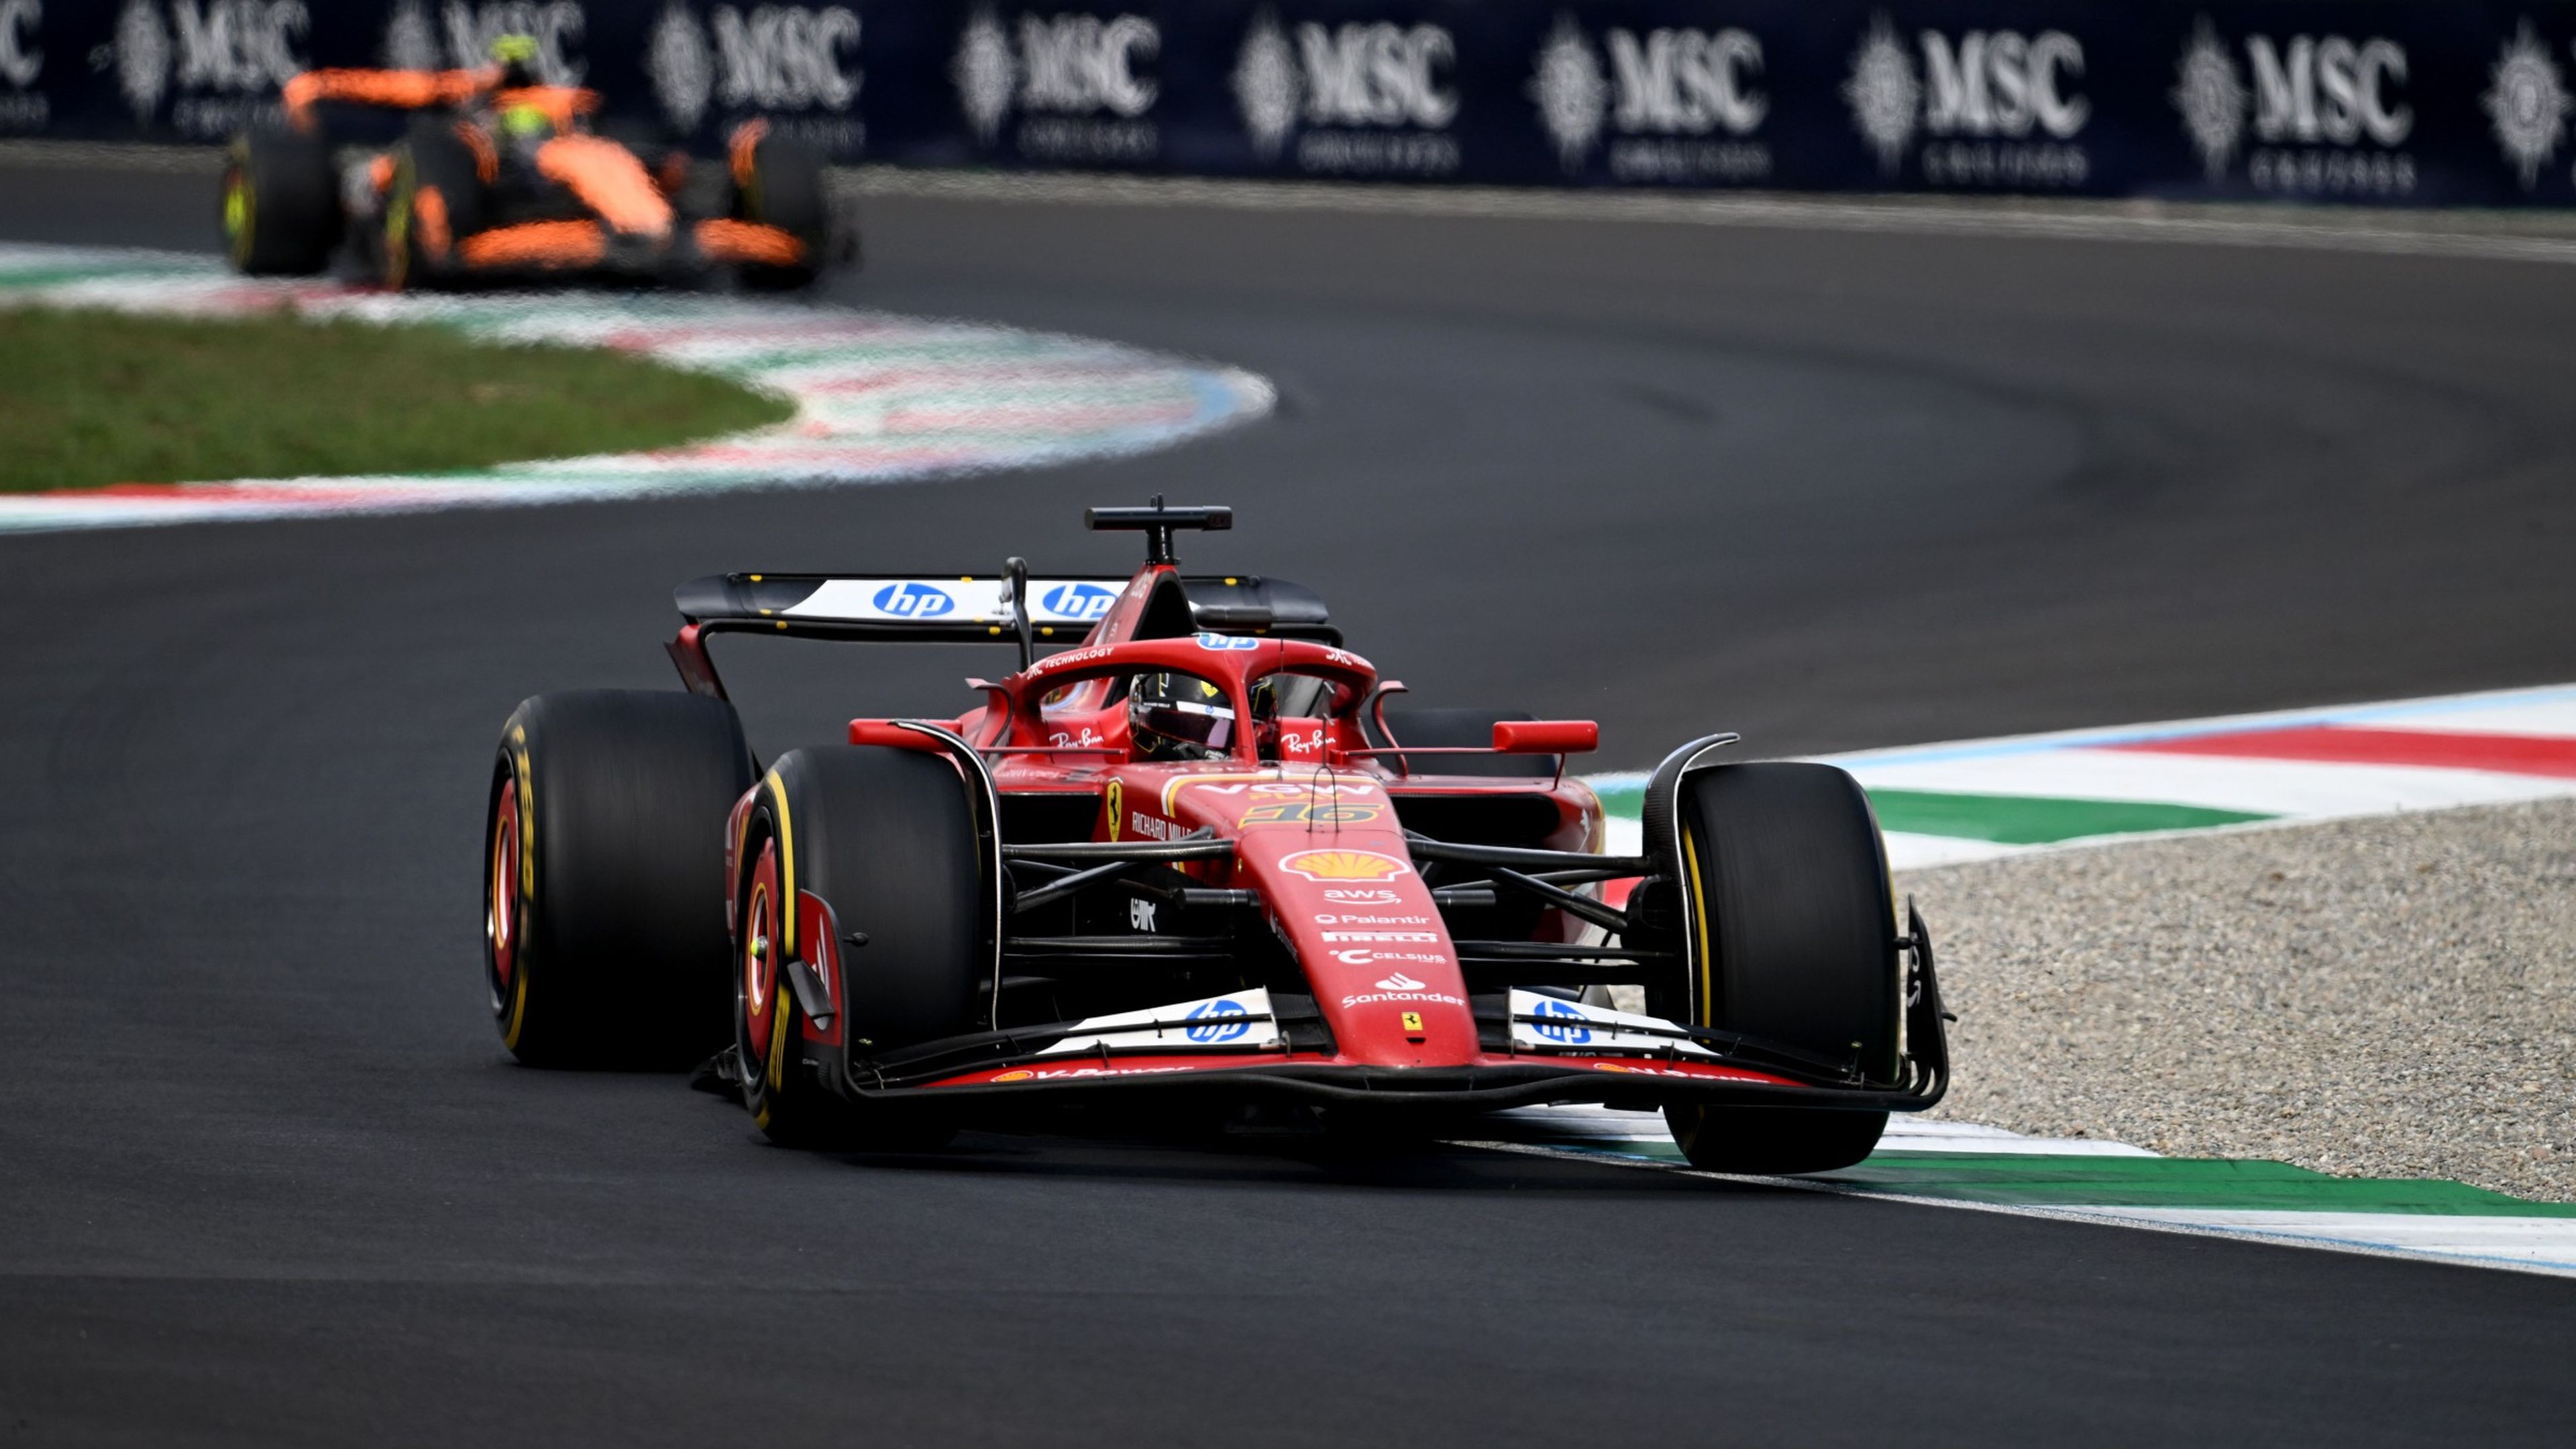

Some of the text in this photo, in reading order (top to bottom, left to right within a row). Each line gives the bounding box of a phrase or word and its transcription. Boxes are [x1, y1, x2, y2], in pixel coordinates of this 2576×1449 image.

[712, 4, 864, 109] MSC
[1298, 21, 1459, 127] MSC
[1607, 27, 1769, 133] MSC
[1920, 31, 2091, 138] MSC
[2244, 34, 2414, 146] MSC
[884, 582, 947, 619] hp
[1053, 584, 1117, 619] hp
[1045, 647, 1114, 669] TECHNOLOGY
[1194, 783, 1375, 796] VGW
[1132, 811, 1166, 841] RICHARD
[1237, 803, 1385, 830] 16
[1324, 890, 1397, 900] aws
[1341, 914, 1431, 924] Palantir
[1321, 931, 1438, 943] PIRELLI
[1373, 952, 1446, 961] CELSIUS
[1342, 991, 1466, 1009] Santander
[1191, 1000, 1243, 1042] hp
